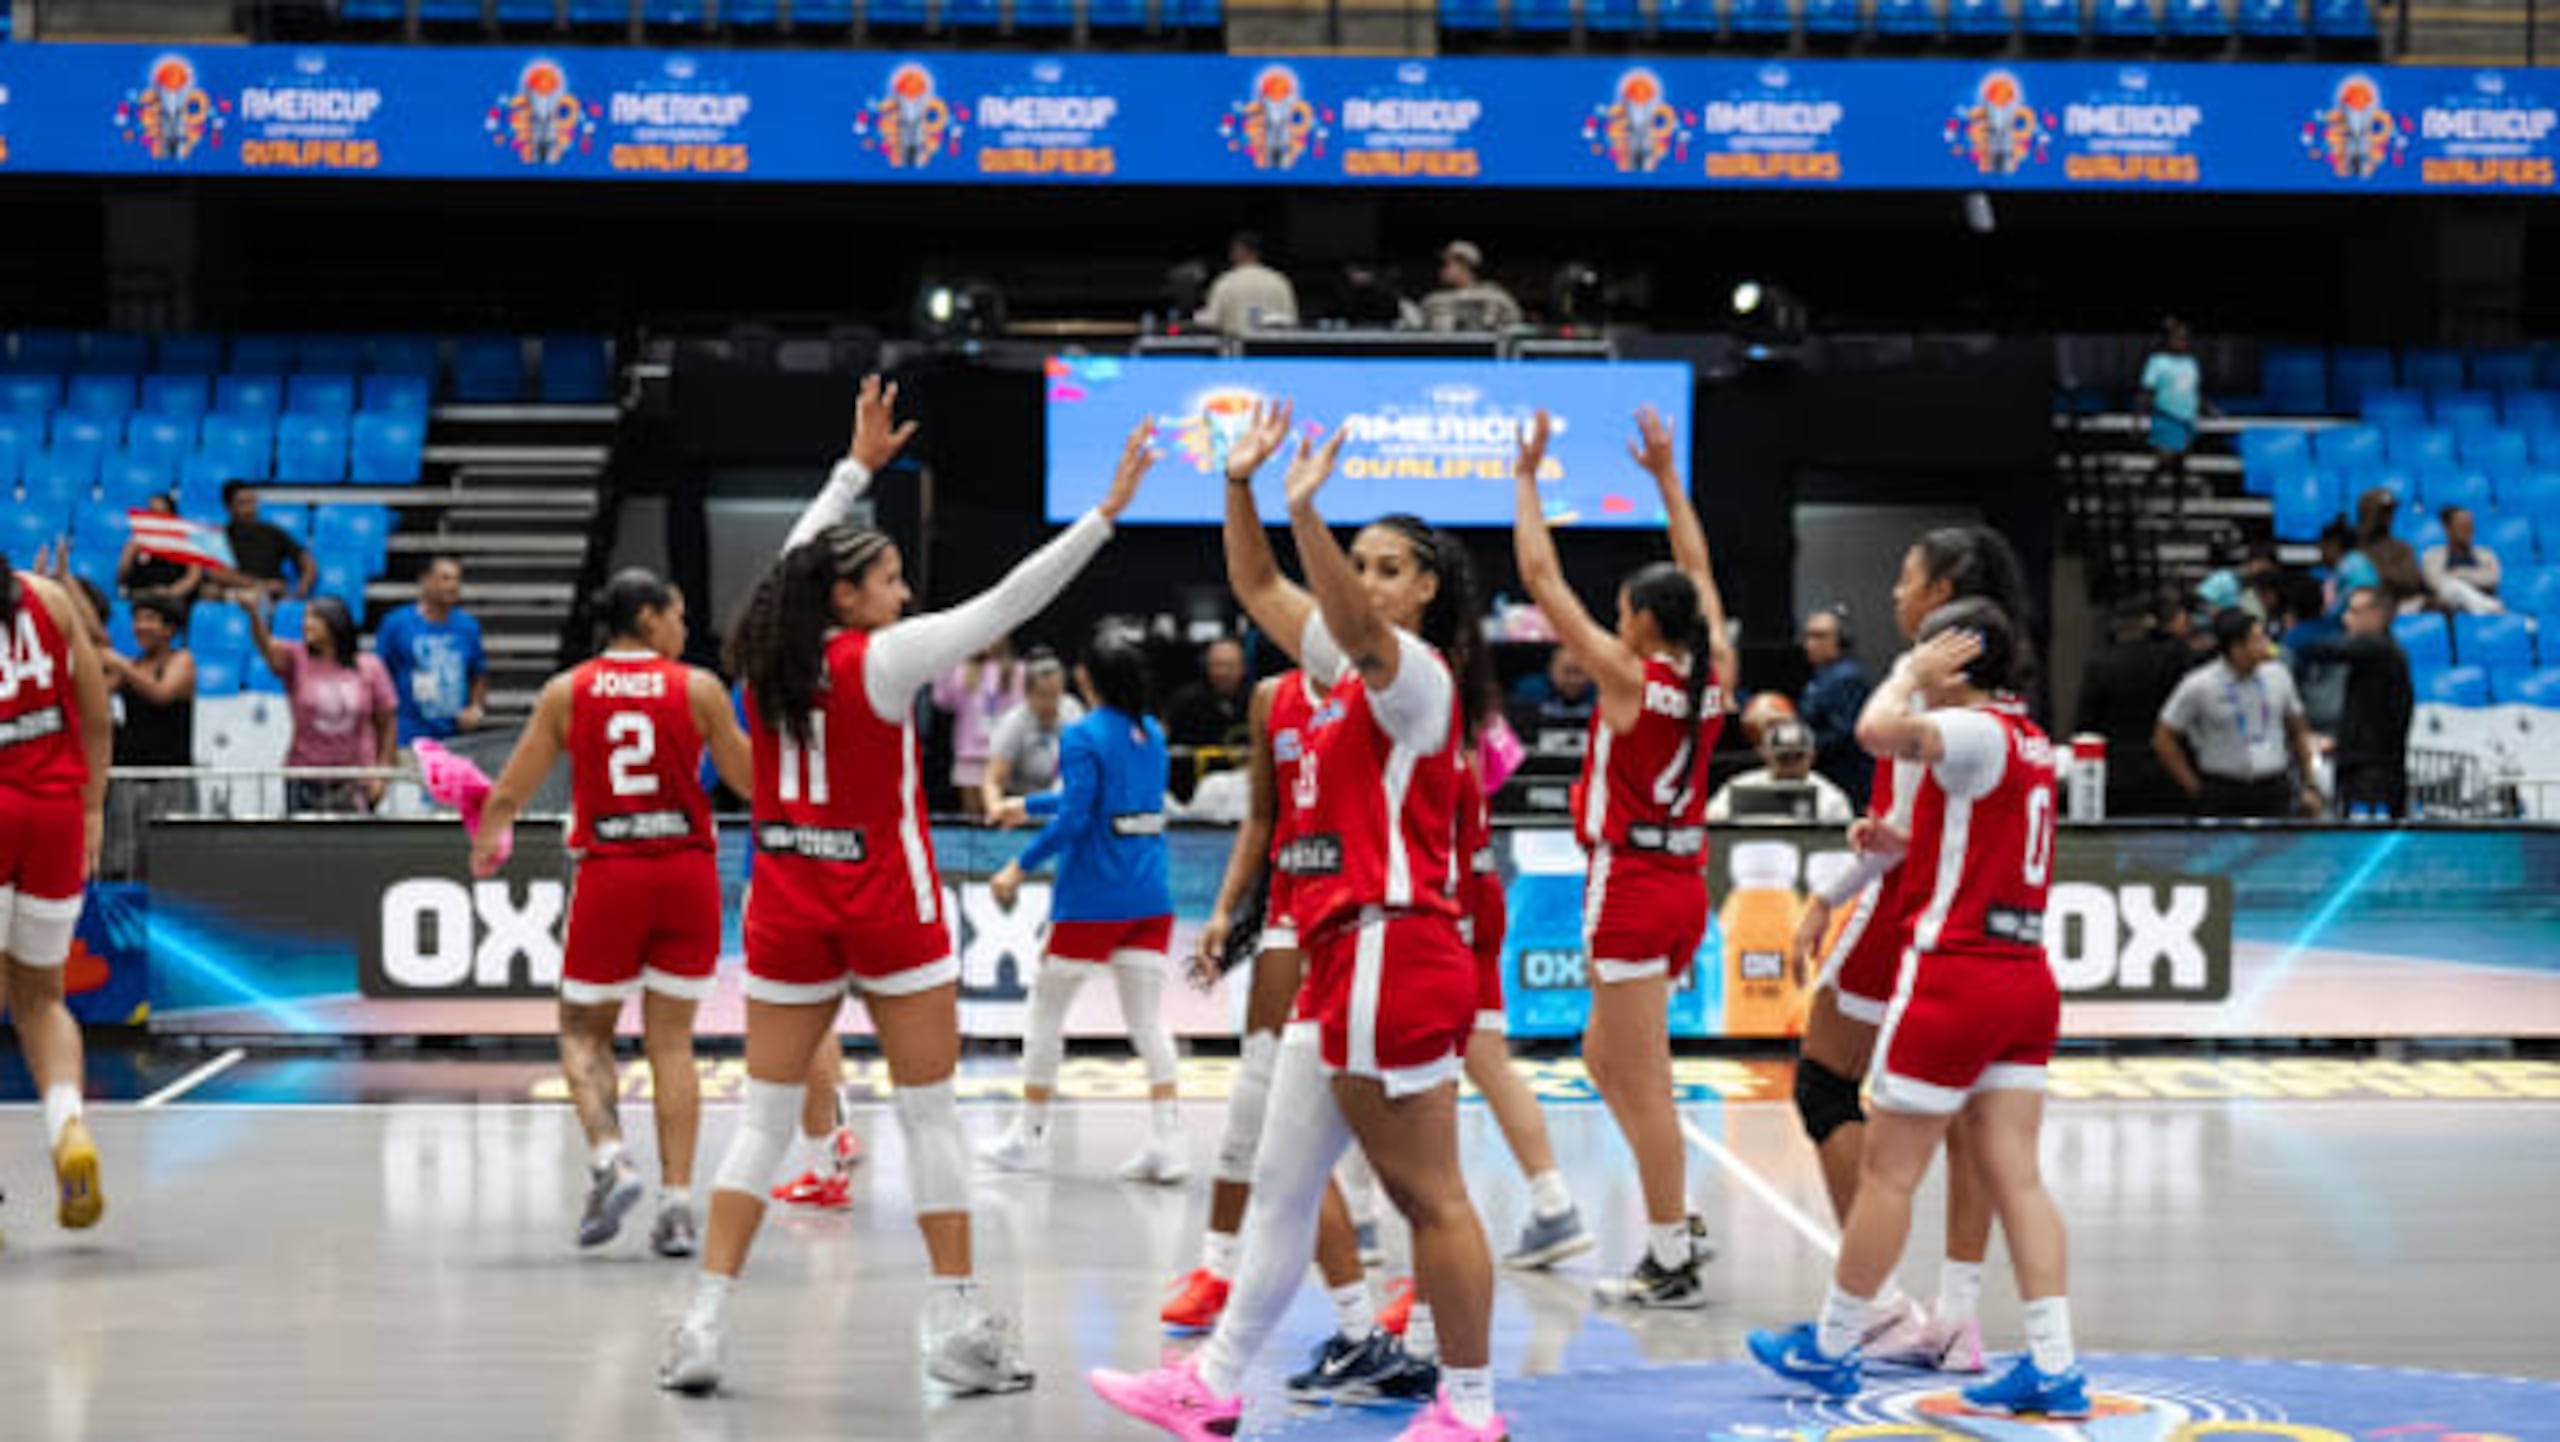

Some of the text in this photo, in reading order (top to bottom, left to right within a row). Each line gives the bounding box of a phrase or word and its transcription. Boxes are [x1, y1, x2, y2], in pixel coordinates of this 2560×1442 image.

[241, 88, 381, 122] AMERICUP
[611, 93, 750, 126] AMERICUP
[978, 96, 1117, 130] AMERICUP
[1343, 99, 1481, 132] AMERICUP
[1705, 101, 1843, 134] AMERICUP
[2065, 105, 2201, 137] AMERICUP
[2422, 109, 2557, 140] AMERICUP
[1343, 456, 1564, 479] QUALIFIES
[591, 671, 666, 698] JONES
[606, 711, 660, 796] 2
[779, 708, 827, 804] 11
[382, 877, 565, 987] OX
[942, 882, 1052, 987] X
[2044, 882, 2208, 990] OX
[1524, 953, 1587, 987] OX
